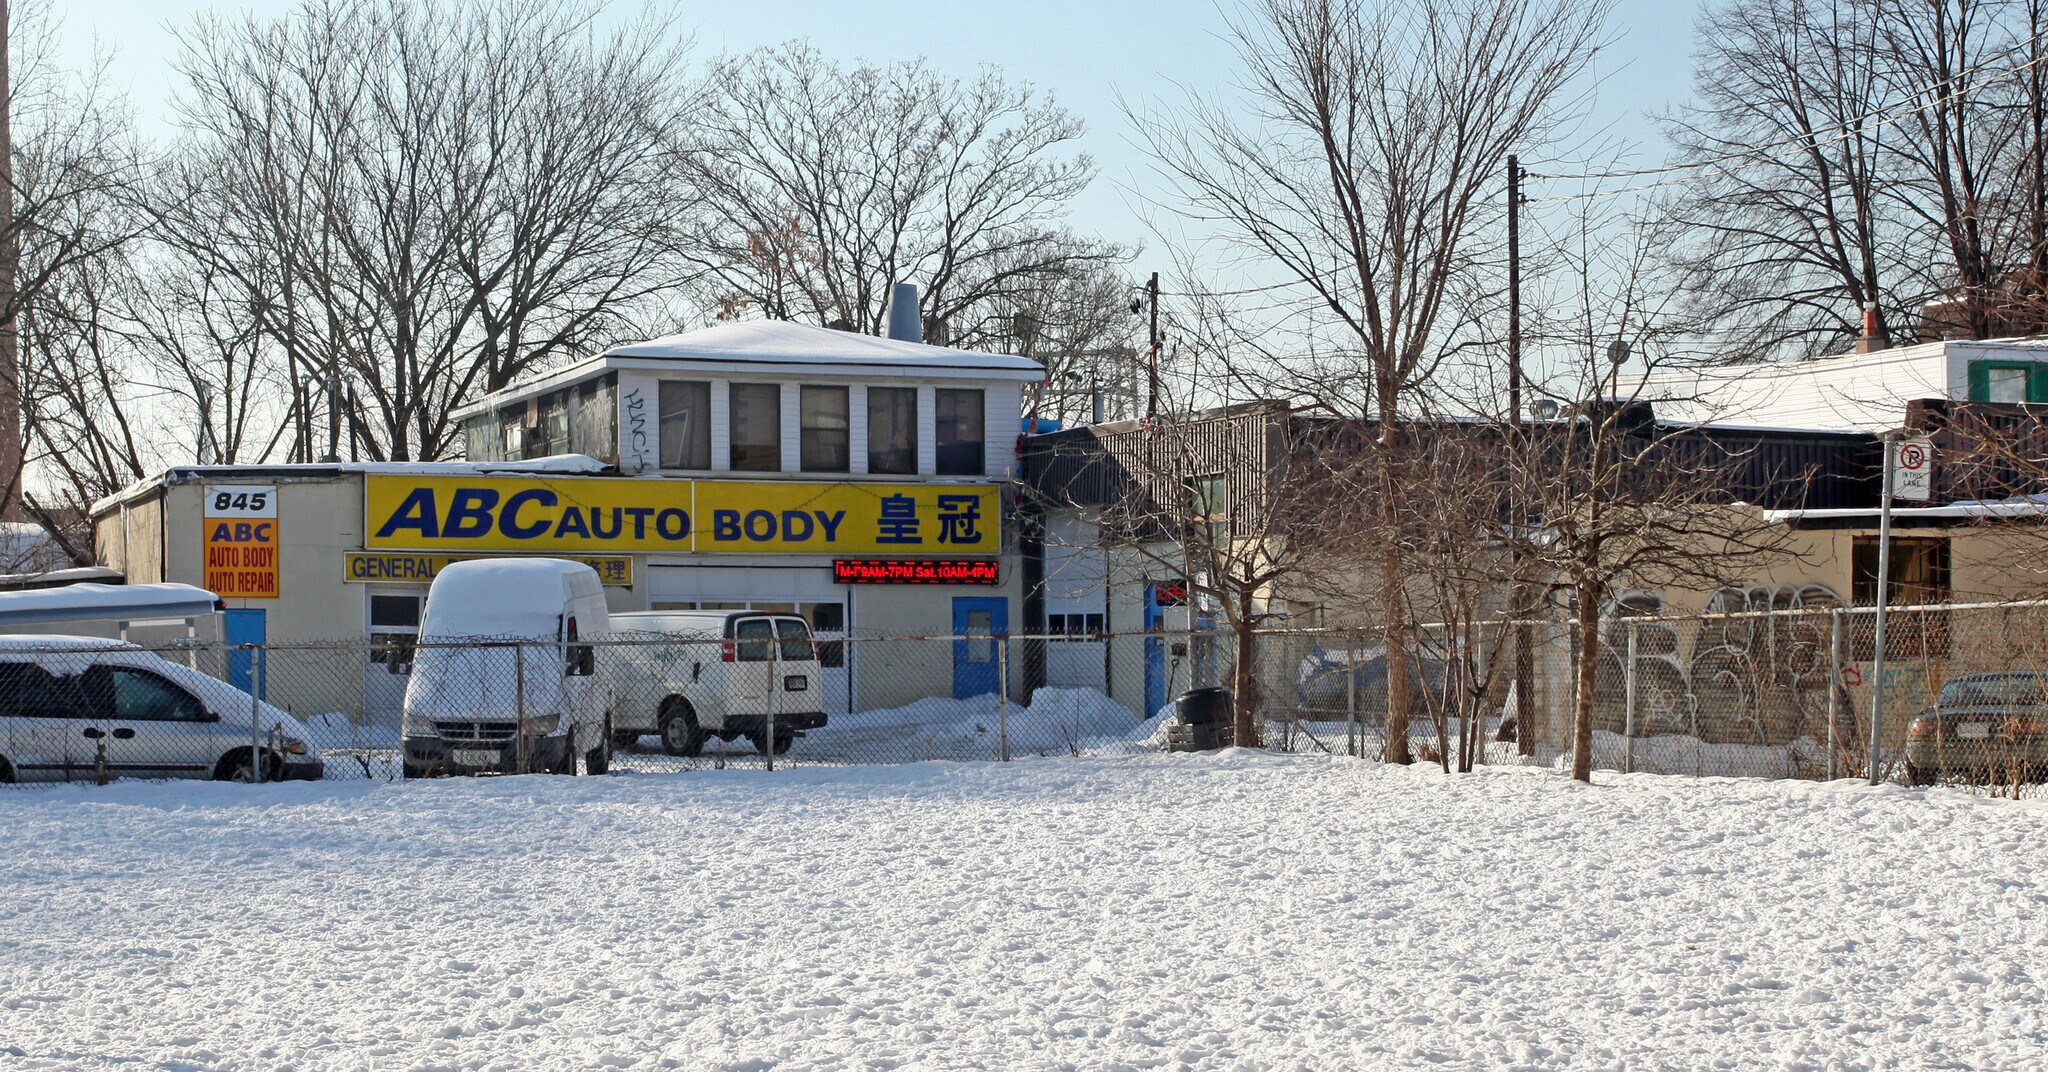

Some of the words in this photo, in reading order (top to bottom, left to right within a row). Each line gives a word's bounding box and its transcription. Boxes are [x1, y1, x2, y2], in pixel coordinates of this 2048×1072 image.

[215, 492, 267, 511] 845
[375, 488, 558, 540] ABC
[553, 507, 691, 541] AUTO
[713, 509, 847, 543] BODY
[876, 493, 982, 544] 皇冠
[210, 523, 272, 543] ABC
[209, 547, 239, 568] AUTO
[243, 547, 274, 568] BODY
[352, 557, 437, 578] GENERAL
[209, 572, 235, 592] AUTO
[238, 572, 274, 592] REPAIR
